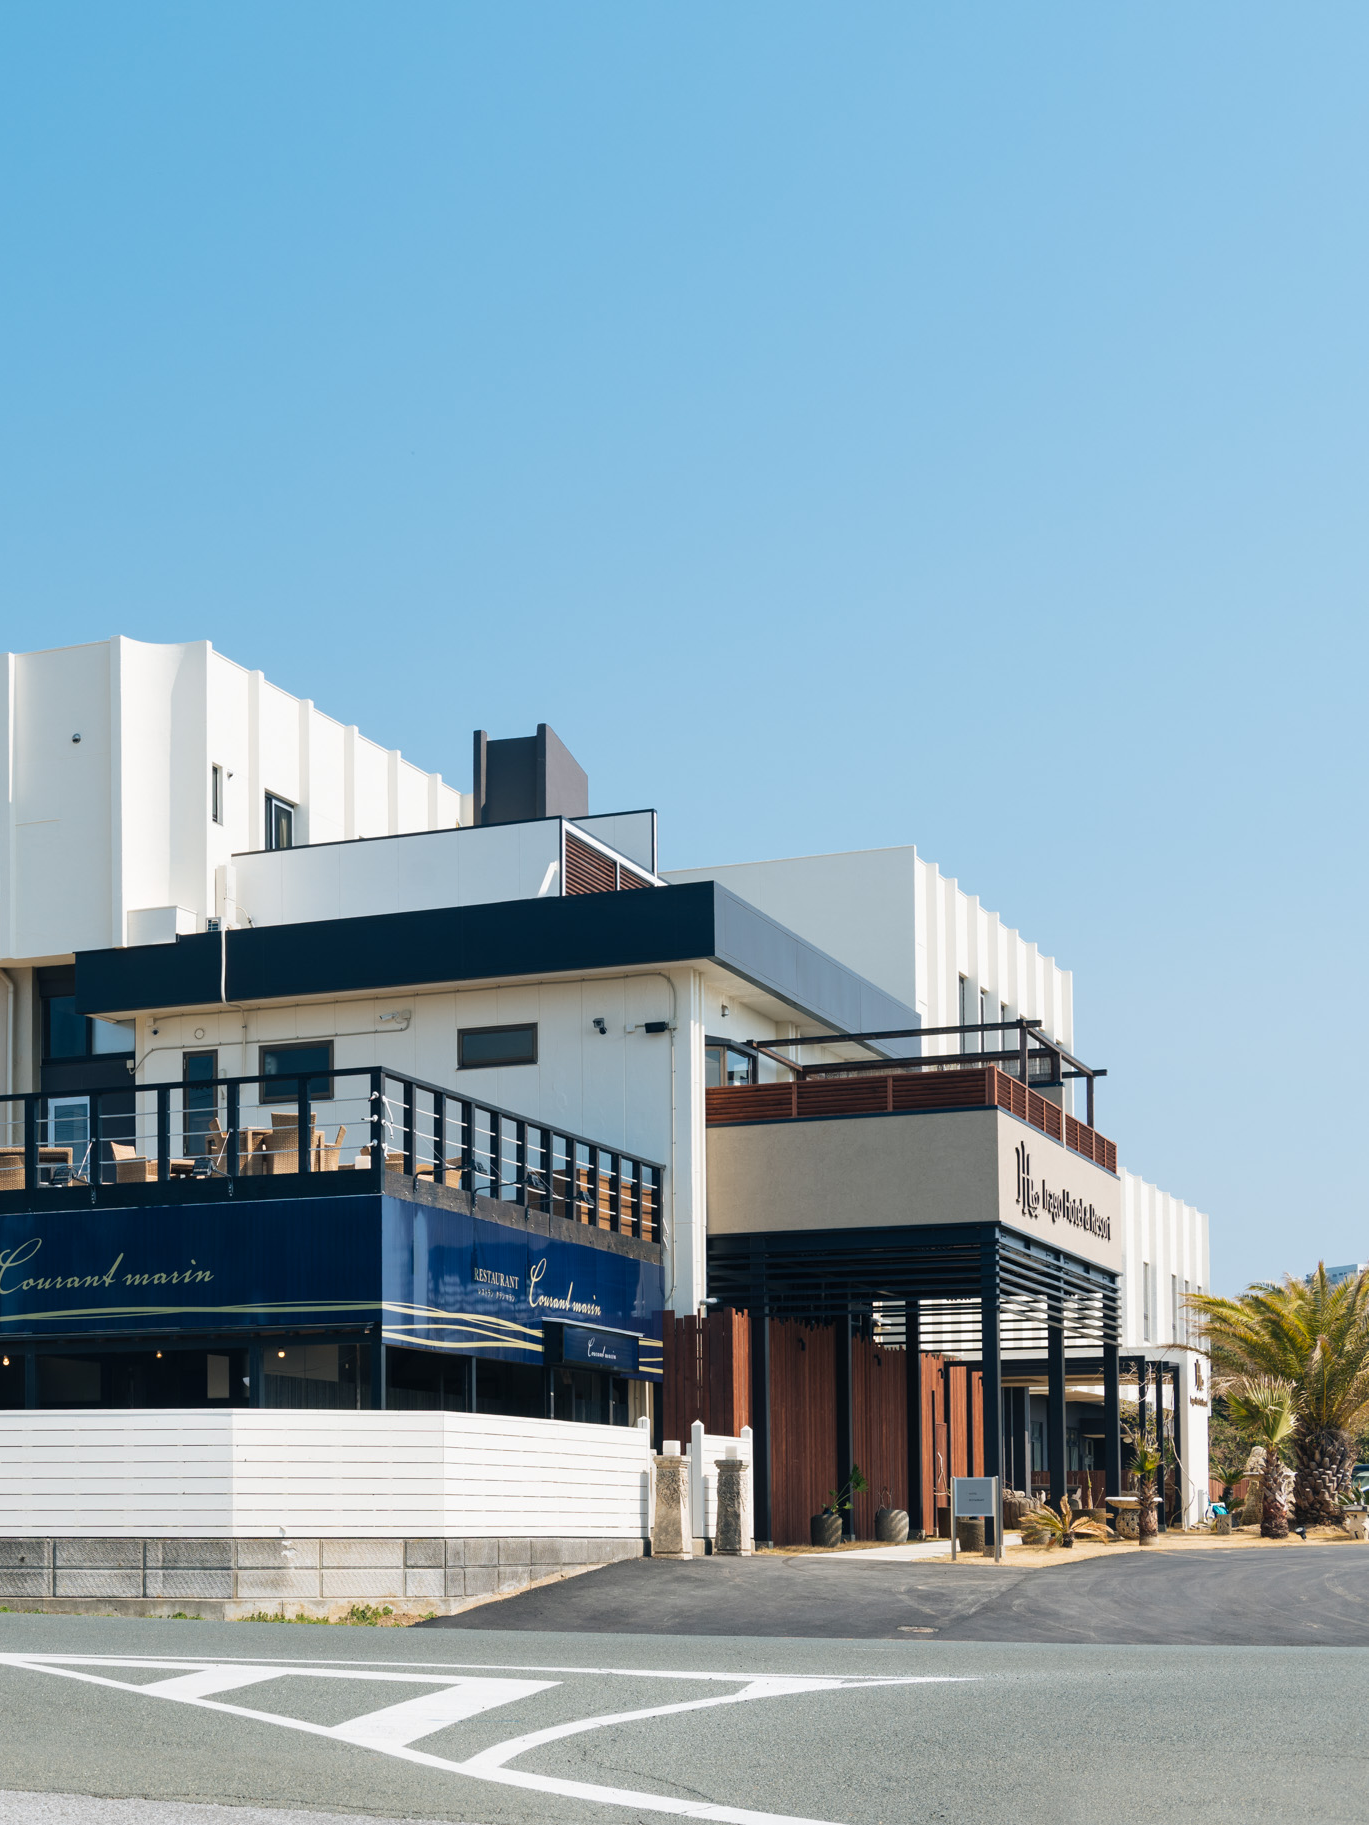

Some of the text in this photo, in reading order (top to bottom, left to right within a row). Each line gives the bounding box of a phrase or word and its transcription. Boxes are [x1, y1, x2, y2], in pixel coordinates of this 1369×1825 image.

[122, 1258, 215, 1286] marin
[474, 1267, 519, 1290] RESTAURANT
[529, 1258, 602, 1316] Courant marin
